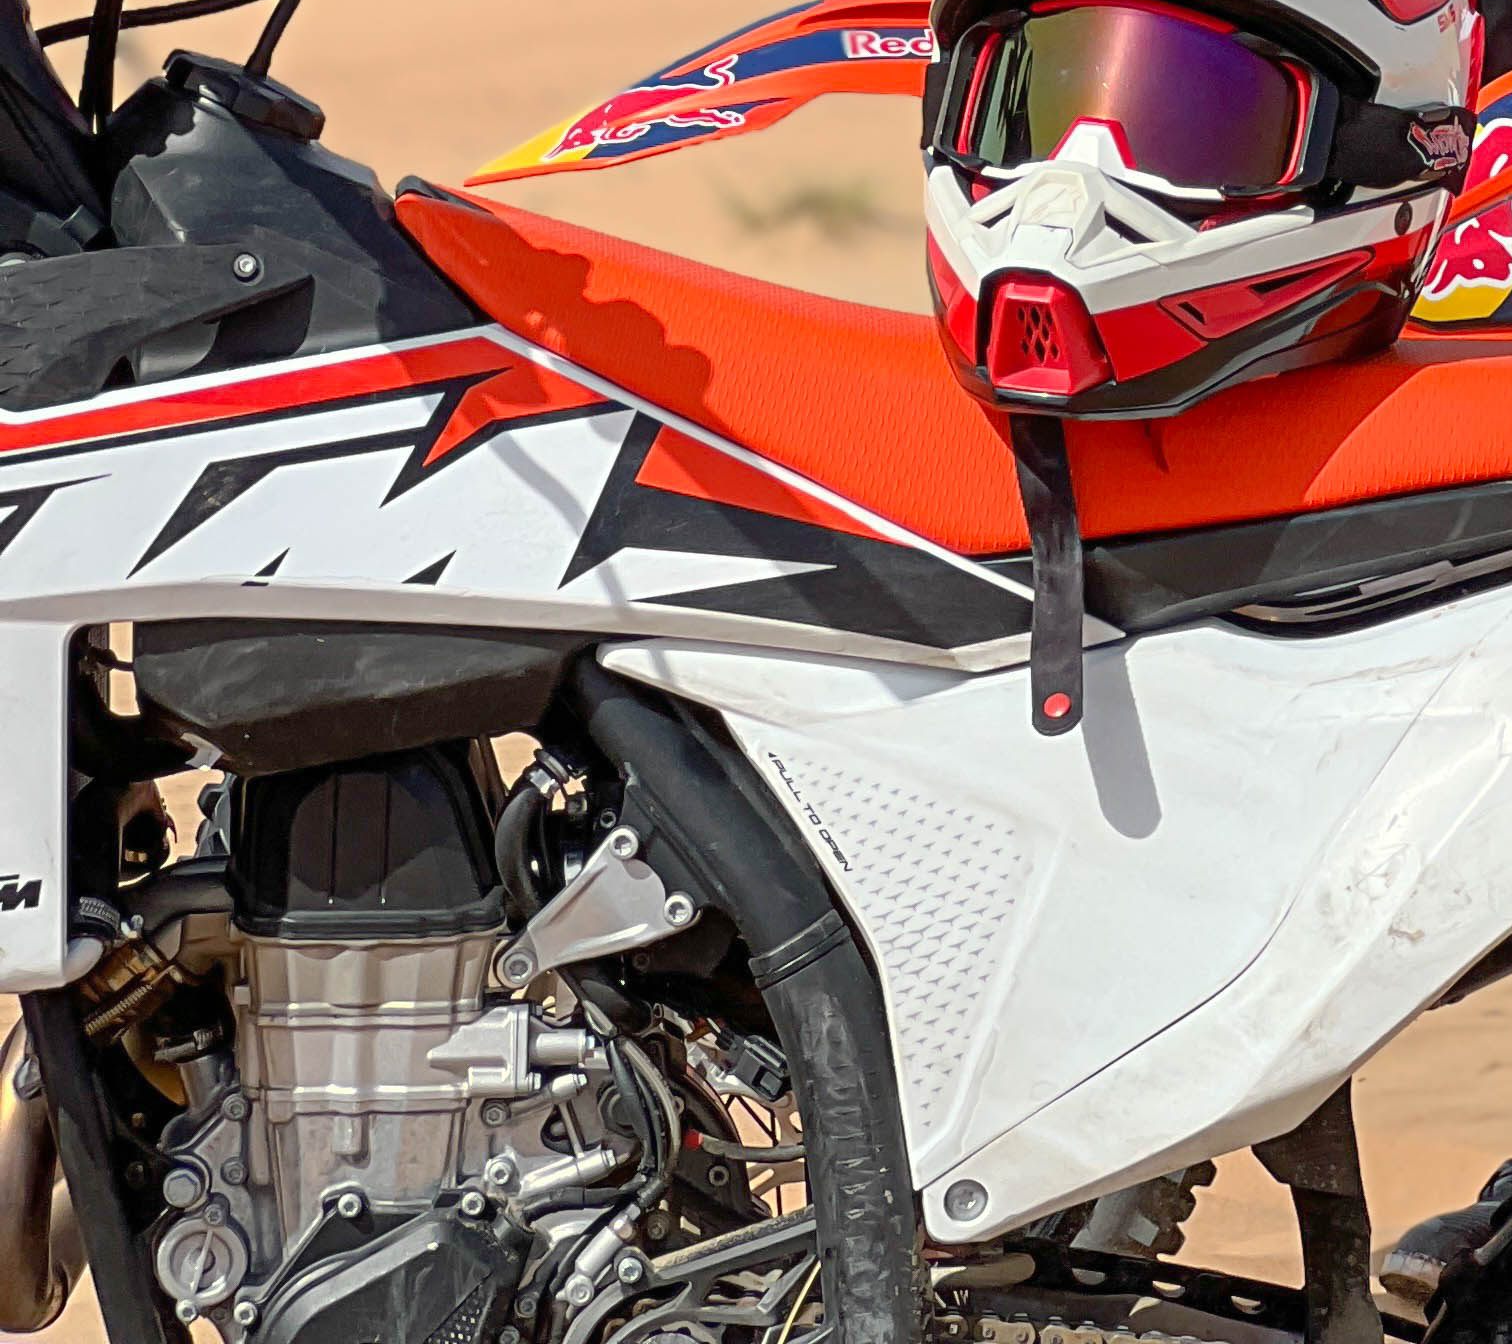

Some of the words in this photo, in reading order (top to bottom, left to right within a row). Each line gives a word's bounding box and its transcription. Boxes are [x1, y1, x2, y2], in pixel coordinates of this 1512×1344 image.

[845, 30, 935, 57] Red
[771, 758, 801, 802] PULL
[803, 803, 822, 825] TO
[818, 828, 852, 872] OPEN
